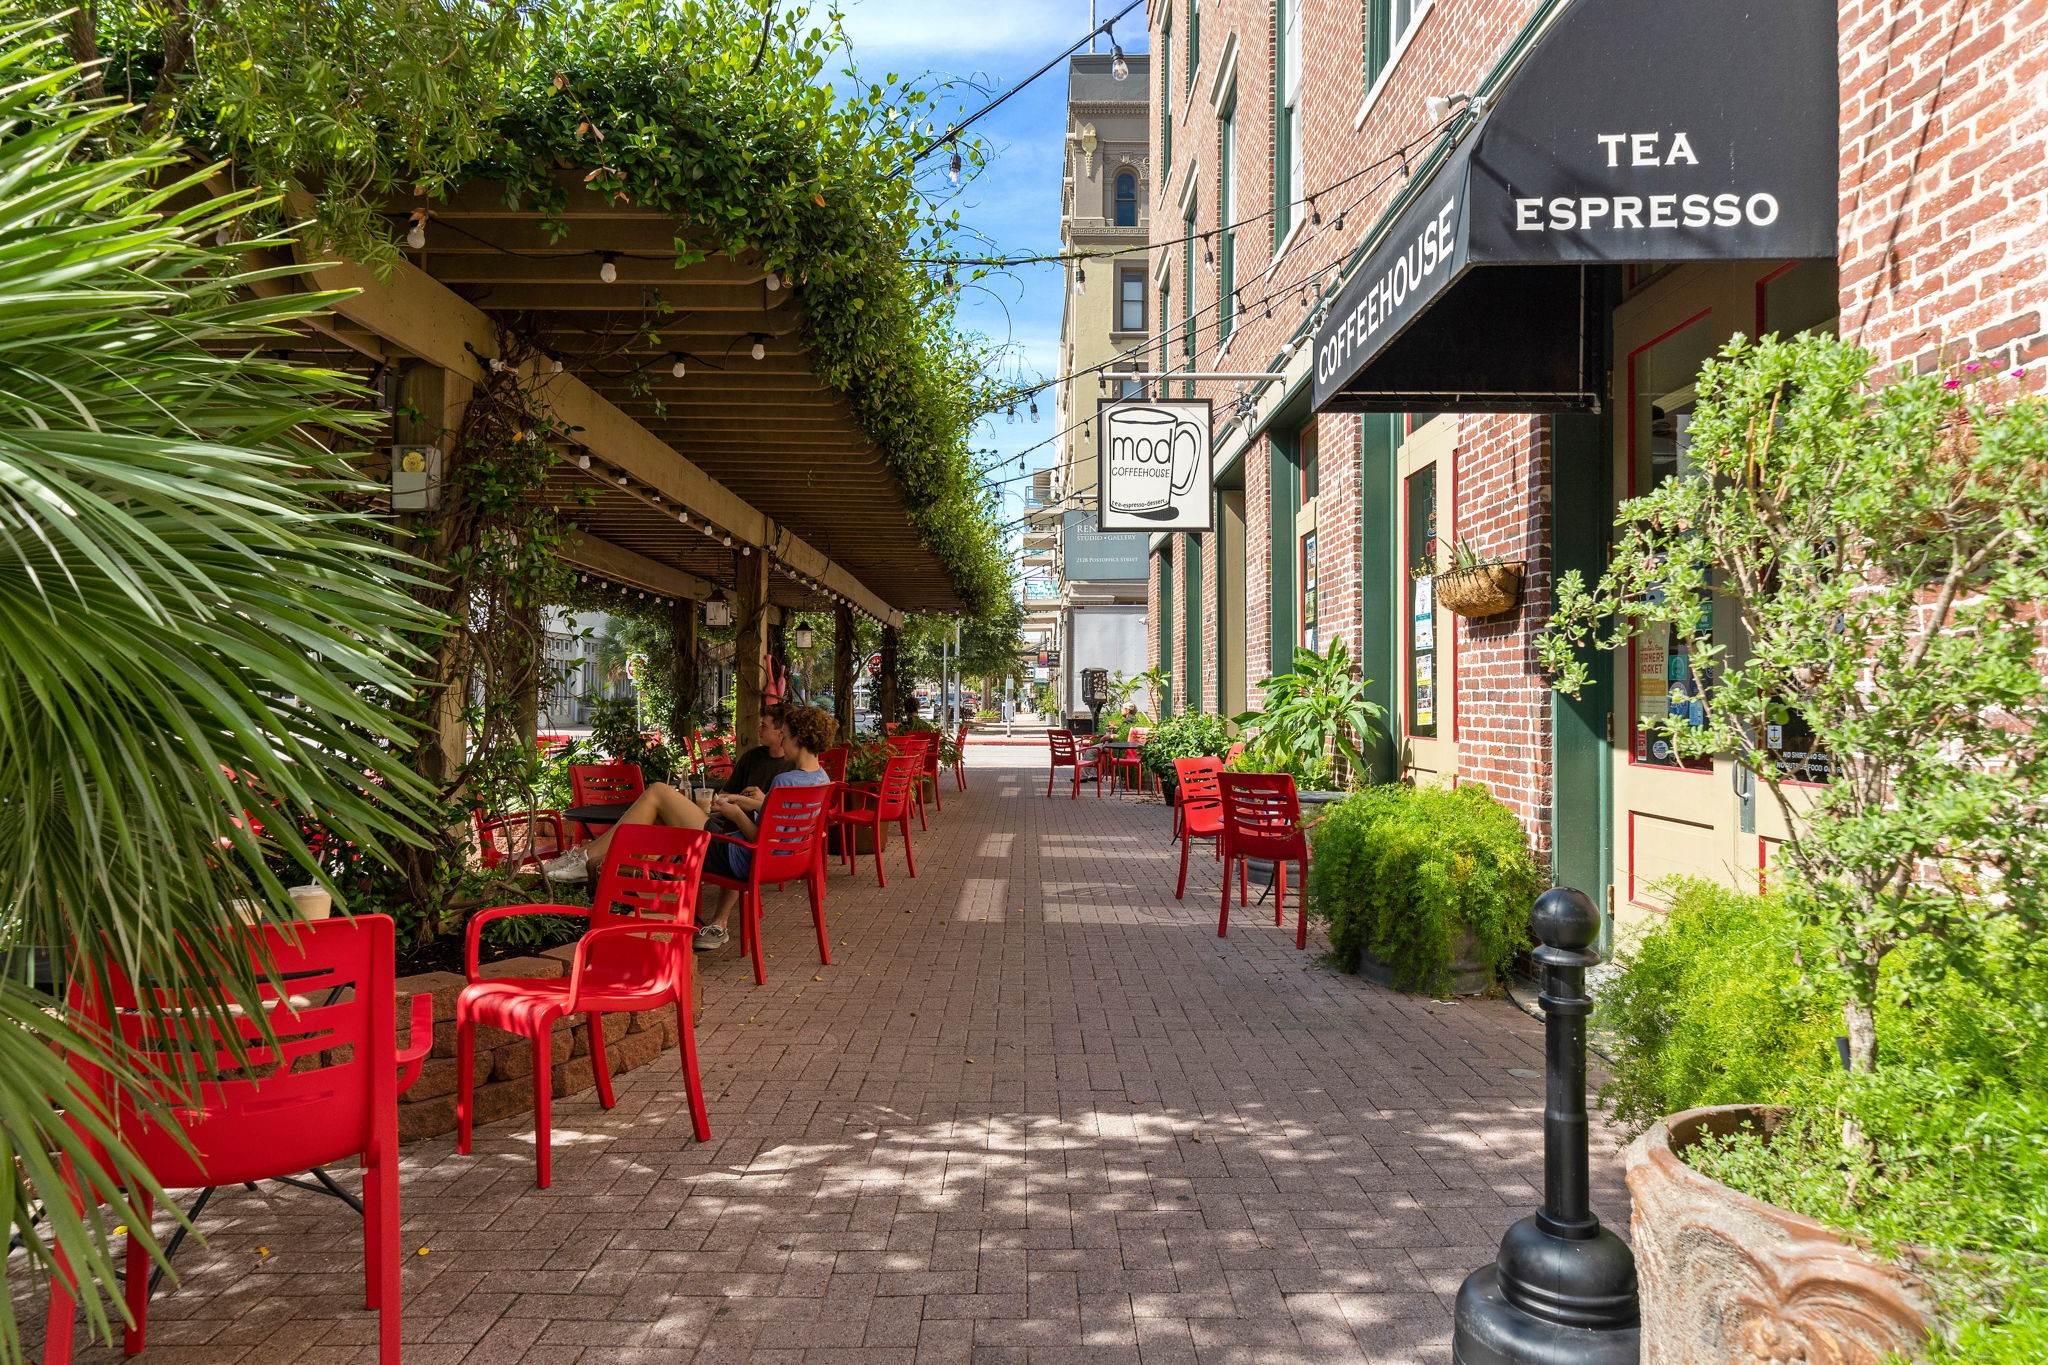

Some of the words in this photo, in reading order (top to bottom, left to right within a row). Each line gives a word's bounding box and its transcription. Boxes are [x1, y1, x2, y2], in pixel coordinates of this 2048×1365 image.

[1597, 132, 1699, 168] TEA
[1516, 192, 1779, 231] ESPRESSO
[1318, 196, 1455, 385] COFFEEHOUSE
[1113, 429, 1172, 464] mod
[1111, 467, 1170, 477] COFFEEHOUSE
[1077, 524, 1098, 533] REN
